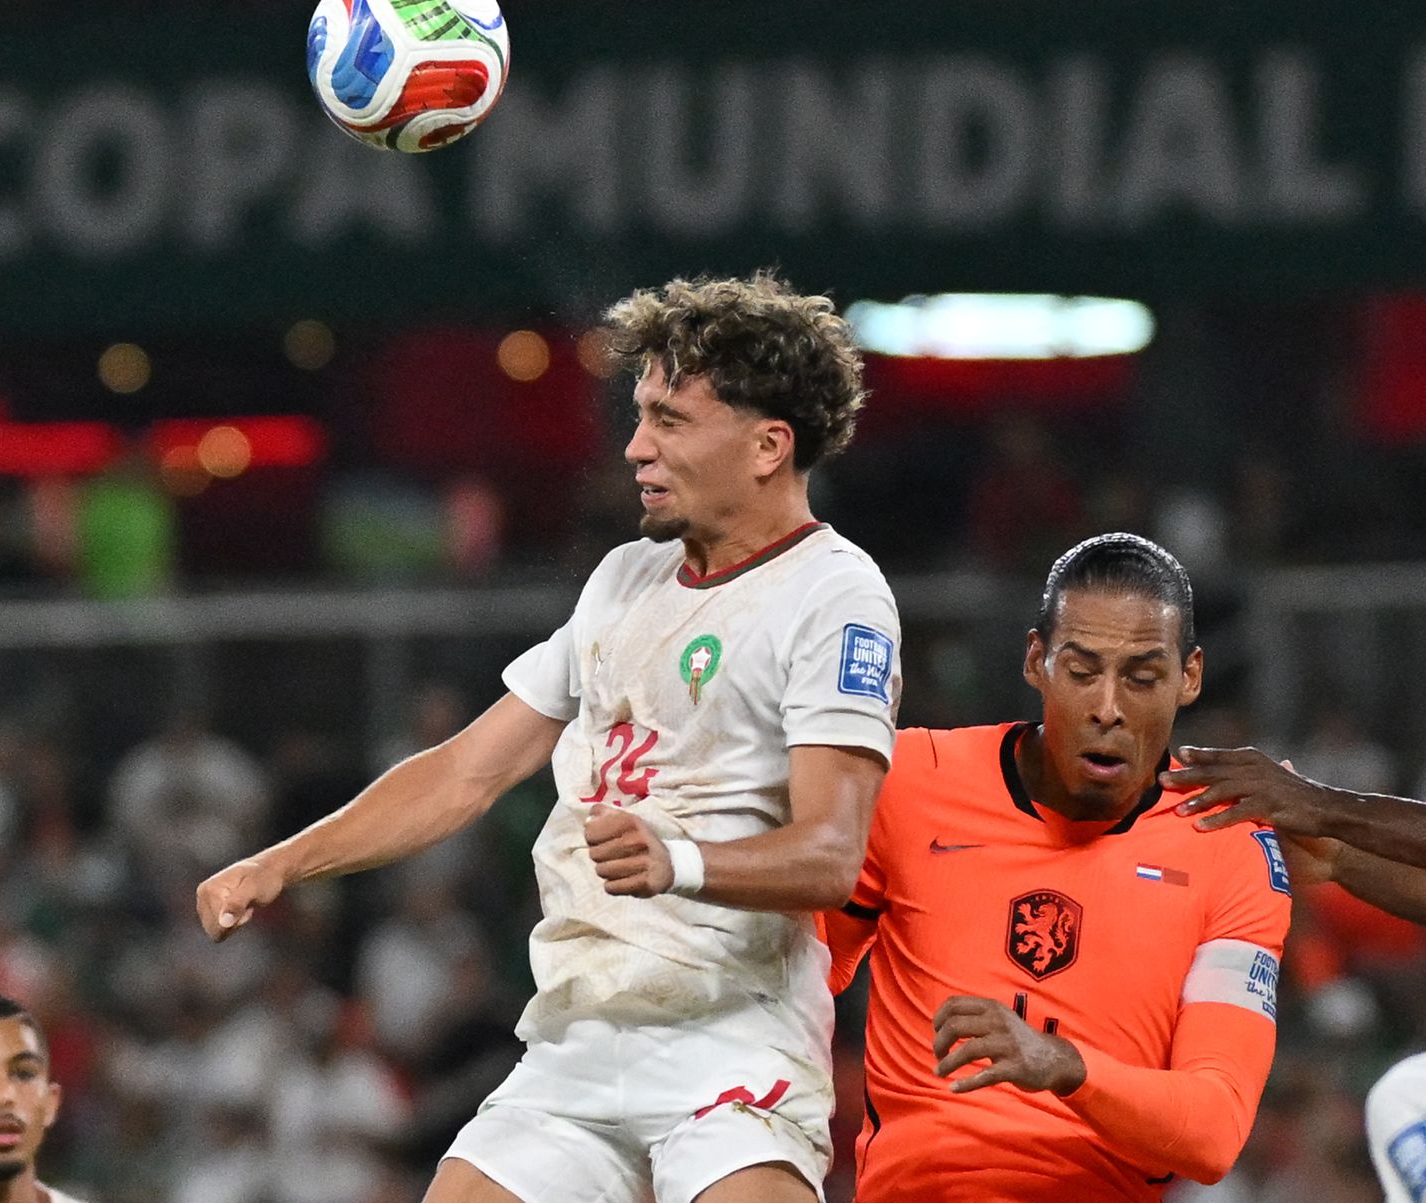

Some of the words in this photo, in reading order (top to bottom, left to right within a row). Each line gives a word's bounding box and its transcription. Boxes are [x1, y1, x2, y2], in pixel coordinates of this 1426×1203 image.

[470, 52, 1349, 235] MUNDIAL
[1249, 962, 1278, 992] UNIT
[1254, 950, 1279, 977] FOOT
